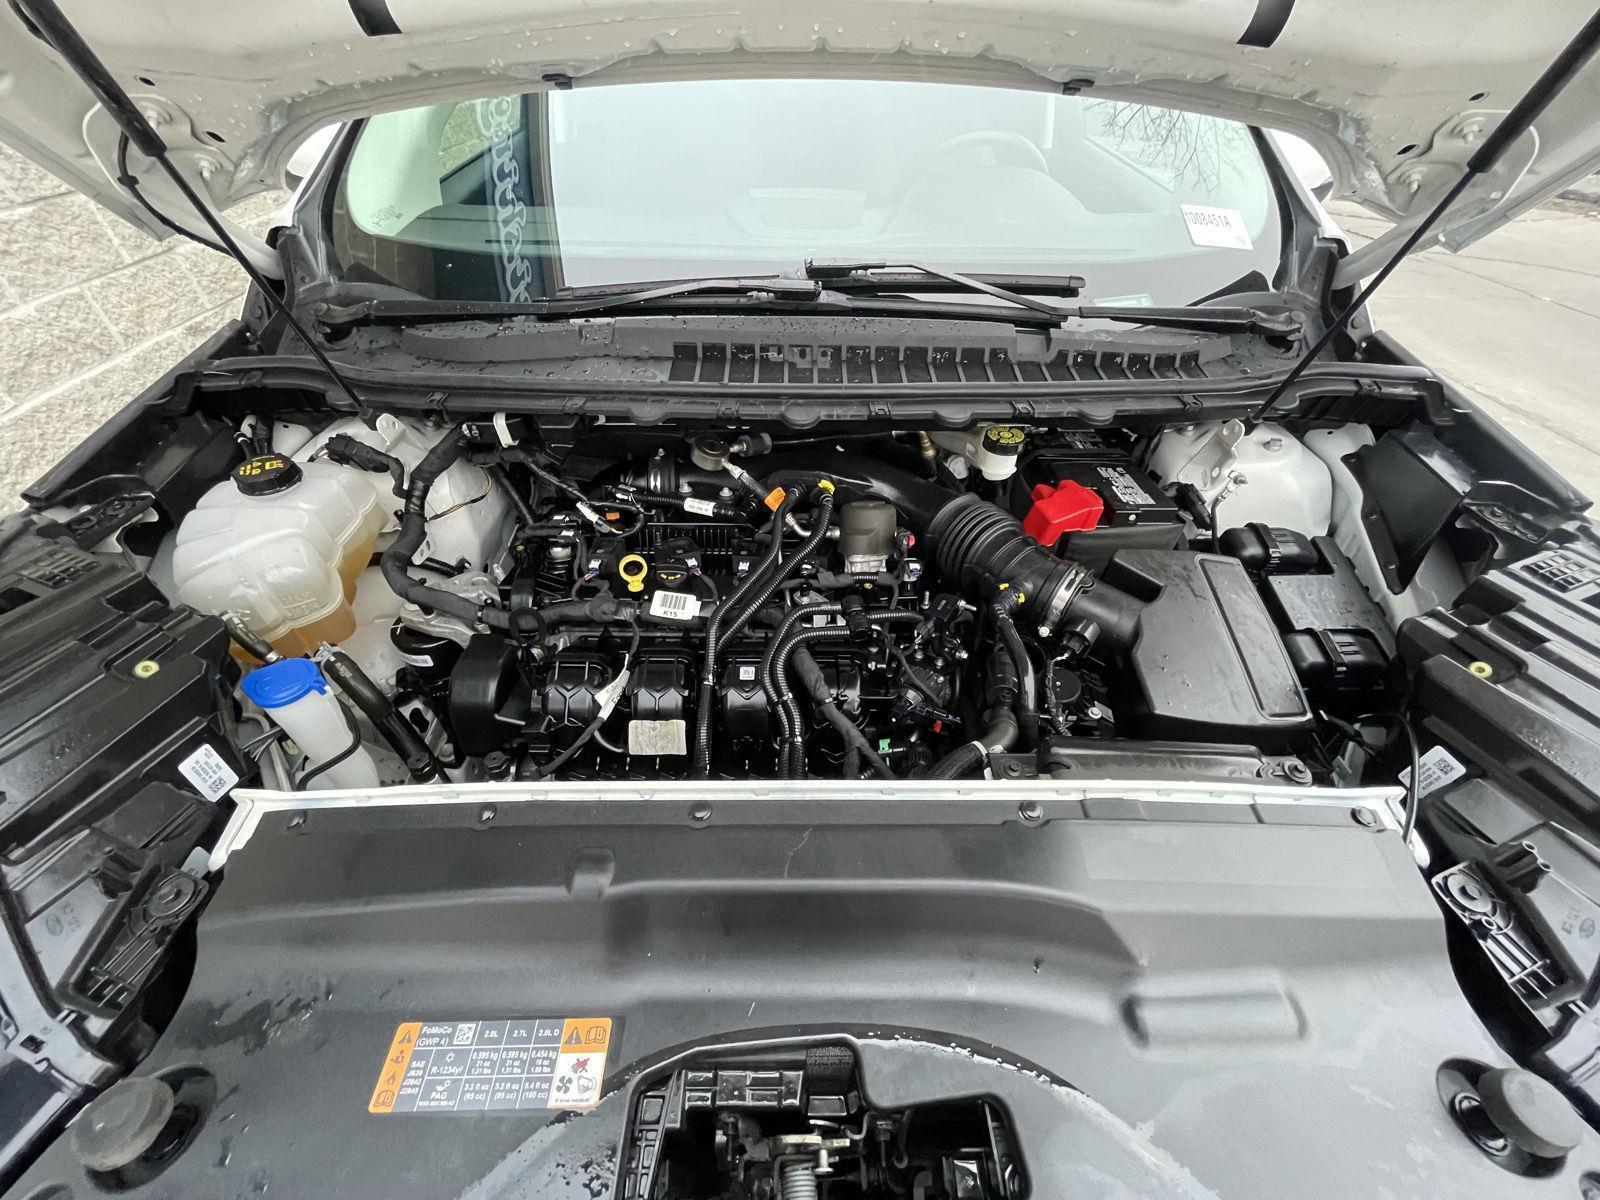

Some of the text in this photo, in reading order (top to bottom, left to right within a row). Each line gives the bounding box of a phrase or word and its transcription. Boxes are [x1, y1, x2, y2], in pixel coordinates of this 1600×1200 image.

[663, 610, 678, 618] K15
[422, 1026, 452, 1034] FoMoCo
[538, 1028, 553, 1036] 2.0L
[416, 1037, 449, 1047] (GWP 4)
[490, 1052, 498, 1061] kg
[520, 1051, 528, 1060] kg
[531, 1050, 557, 1059] 0.454 kg
[431, 1066, 463, 1075] R-1234yf
[463, 1092, 486, 1101] (95 cc)
[494, 1091, 516, 1100] (95 cc)
[537, 1091, 548, 1100] cc)
